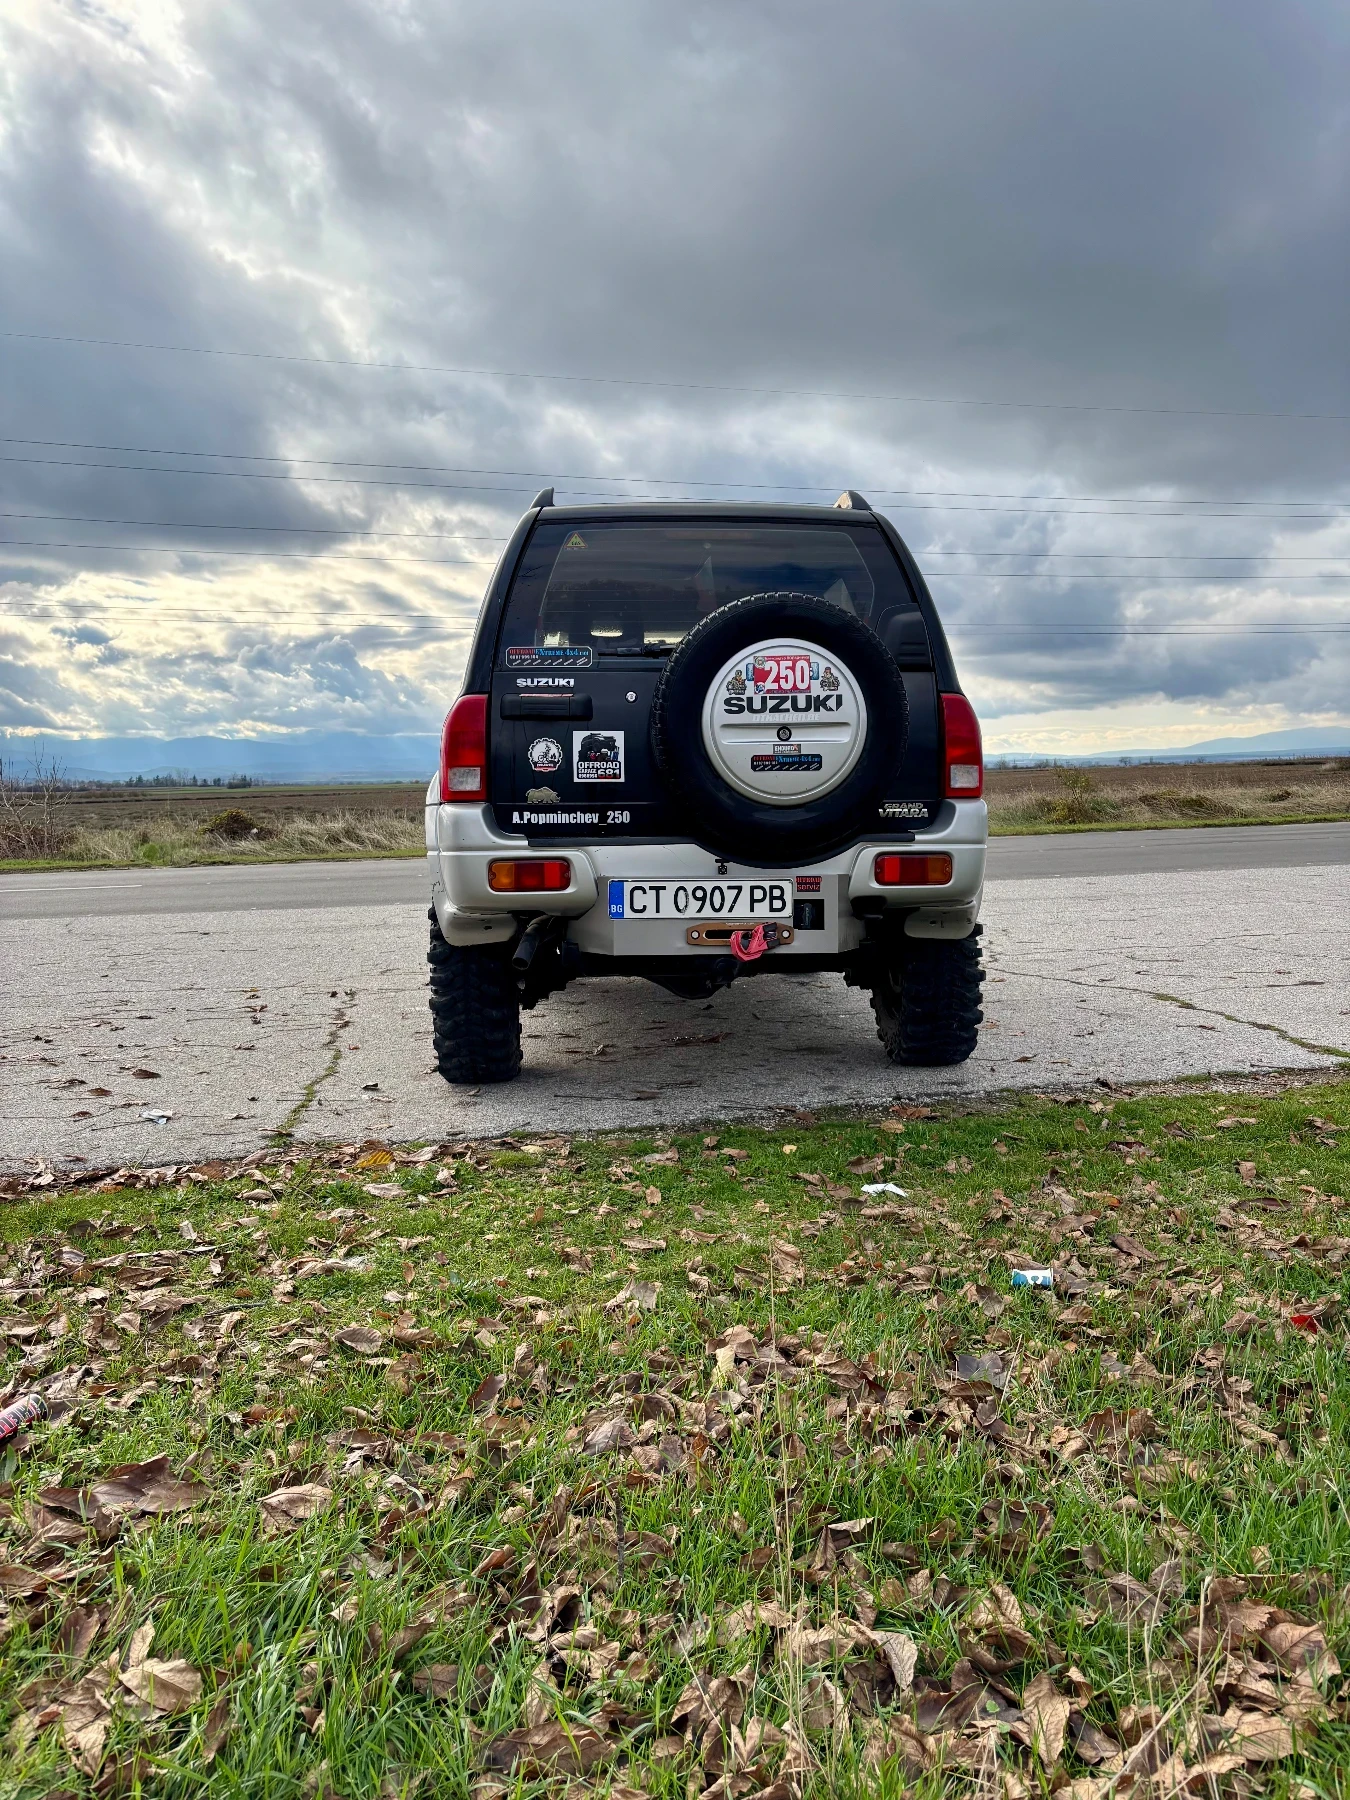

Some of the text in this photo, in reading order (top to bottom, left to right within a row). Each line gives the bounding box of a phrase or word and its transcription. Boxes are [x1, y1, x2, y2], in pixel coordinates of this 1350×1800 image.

[764, 660, 810, 690] 250
[516, 678, 575, 688] SUZUKI
[723, 694, 843, 714] SUZUKI
[578, 761, 620, 769] OFFROAD
[597, 769, 620, 778] 681
[878, 808, 929, 818] VITARA
[629, 885, 787, 914] CT 0907 PB
[611, 905, 623, 913] BG
